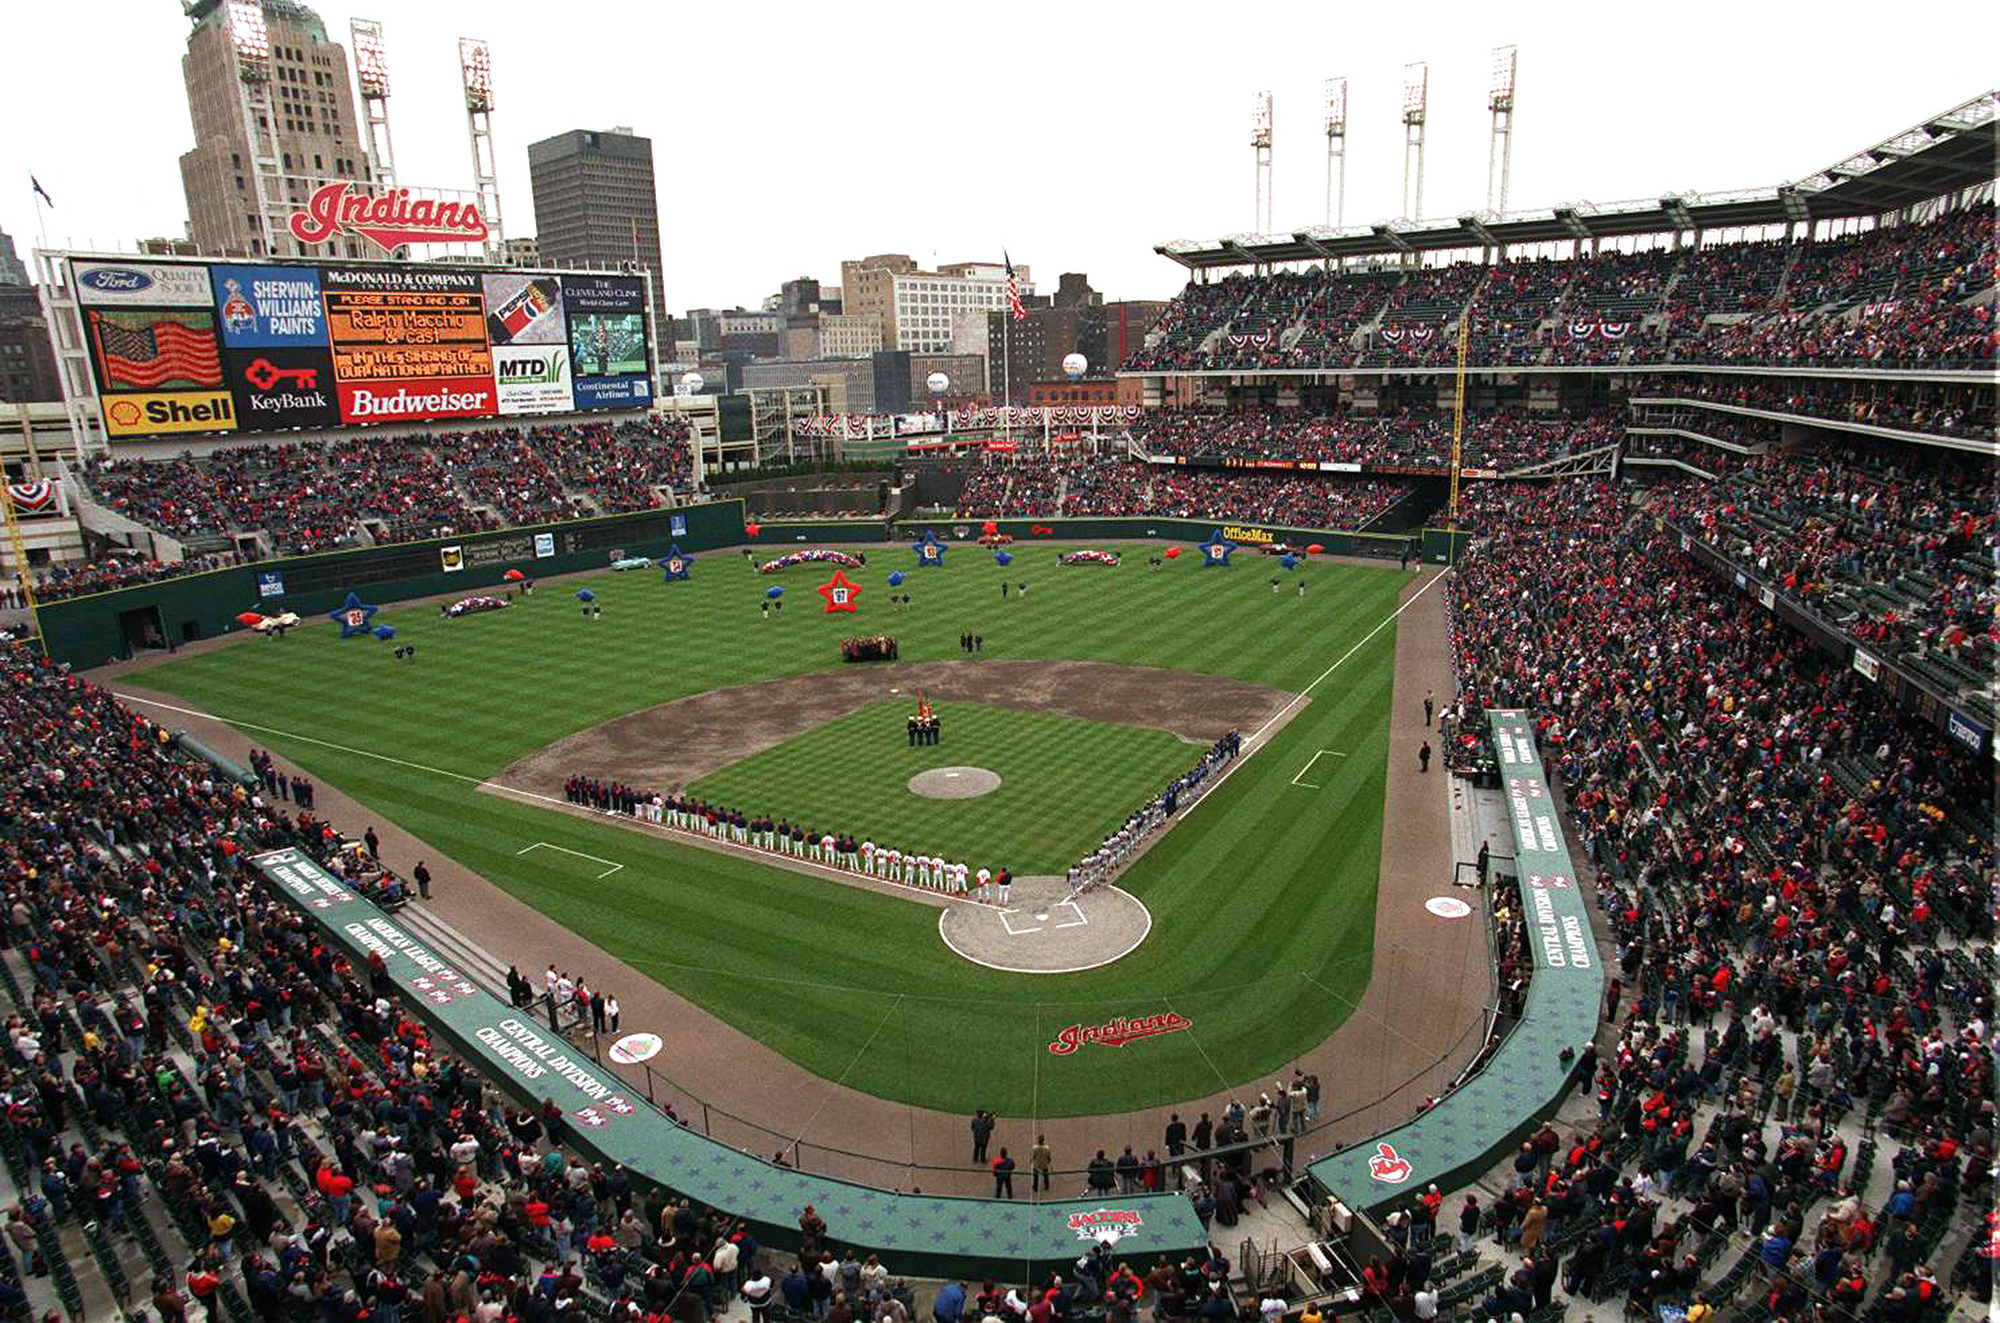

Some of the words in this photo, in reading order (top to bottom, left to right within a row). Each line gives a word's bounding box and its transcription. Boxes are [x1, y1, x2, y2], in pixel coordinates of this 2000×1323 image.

[289, 181, 489, 250] Indians
[95, 270, 140, 289] Ford
[328, 271, 400, 284] McDONALD
[404, 273, 415, 284] &
[415, 274, 475, 286] COMPANY
[253, 280, 320, 299] SHERWIN-
[565, 288, 614, 298] CLEVELAND
[614, 289, 640, 298] CLINIC
[257, 299, 322, 318] WILLIAMS
[341, 295, 384, 305] PLEASE
[388, 296, 423, 305] STAND
[425, 296, 447, 305] AND
[449, 296, 471, 305] JOIN
[498, 289, 530, 319] PEPSI
[270, 317, 316, 335] PAINTS
[351, 310, 397, 329] Ralph
[403, 311, 464, 329] Macchio
[385, 330, 398, 344] &
[406, 328, 440, 344] cast
[353, 352, 367, 364] IN
[373, 351, 398, 364] THE
[405, 351, 453, 364] SINGING
[458, 350, 471, 363] OF
[340, 366, 368, 378] OUR
[373, 365, 432, 378] NATIONAL
[440, 363, 489, 376] ANTHEM
[500, 360, 545, 376] MTD
[577, 381, 629, 391] Continental
[595, 390, 630, 400] Airlines
[146, 398, 231, 423] Shell
[250, 391, 327, 414] KeyBank
[350, 388, 487, 416] Budweiser
[1223, 526, 1273, 542] OfficeMax
[1532, 887, 1556, 924] DIVISION
[344, 922, 397, 959] CHAMPIONS
[366, 918, 413, 949] AMERICAN
[403, 945, 446, 973] LEAGUE
[1541, 925, 1566, 967] CENTRAL
[1561, 916, 1590, 969] CHAMPIONS
[1049, 1012, 1193, 1055] Indians
[475, 1027, 547, 1079] CHAMPIONS
[499, 1018, 551, 1060] CENTRAL
[547, 1054, 613, 1100] DIVISION
